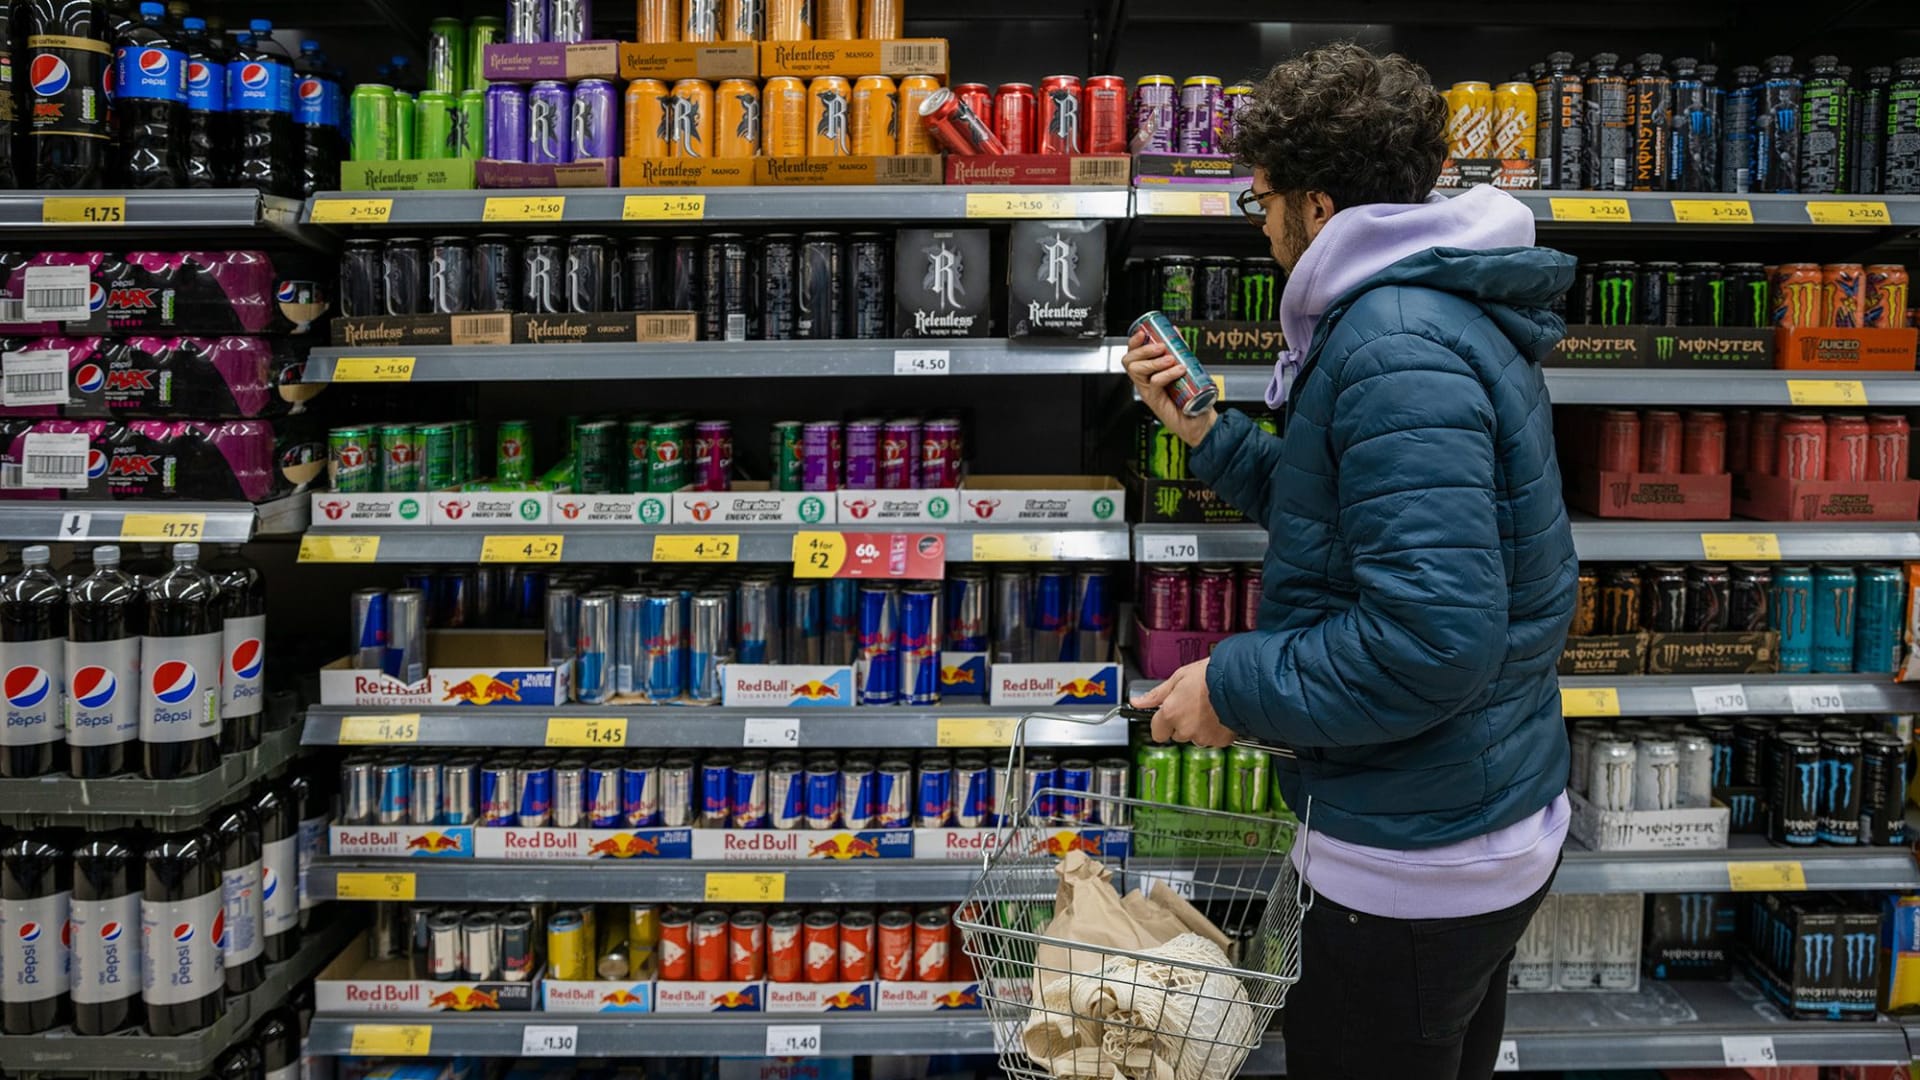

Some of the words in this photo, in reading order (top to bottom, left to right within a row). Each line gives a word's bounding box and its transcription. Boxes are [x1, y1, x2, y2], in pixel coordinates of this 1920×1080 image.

[490, 54, 532, 70] Relentless
[627, 53, 669, 69] Relentless
[775, 46, 836, 70] Relentless
[845, 51, 874, 59] MANGO
[142, 77, 166, 87] pepsi
[243, 90, 266, 98] pepsi
[827, 93, 850, 156] R
[1058, 90, 1081, 155] R
[1636, 91, 1654, 180] MONSTER
[643, 159, 703, 184] Relentless
[767, 158, 831, 182] Relentless
[839, 163, 867, 171] MANGO
[954, 161, 1016, 182] Relentless
[1025, 166, 1057, 175] CHERRY
[365, 168, 419, 190] Relentless
[1433, 176, 1462, 188] ERT
[1491, 176, 1538, 188] ALERT
[351, 207, 357, 215] 2
[524, 205, 530, 213] 2
[664, 203, 670, 211] 2
[1006, 201, 1012, 210] 2
[1712, 208, 1719, 216] 2
[1848, 209, 1855, 217] 2
[84, 206, 121, 222] £1.75
[1046, 231, 1075, 301] R
[111, 278, 135, 288] pepsi
[526, 249, 558, 313] R
[932, 243, 964, 309] R
[107, 287, 160, 309] MAX
[1027, 299, 1089, 327] Relentless
[527, 319, 588, 341] Relentless
[597, 325, 624, 333] ORIGIN
[914, 310, 975, 335] Relentless
[345, 322, 404, 344] Relentless
[412, 326, 441, 335] ORIGIN
[1205, 328, 1285, 350] MONST
[1554, 337, 1637, 352] MONSTER
[1679, 337, 1765, 353] MONSTER
[1817, 339, 1860, 350] JUICED
[1225, 351, 1273, 360] ENER
[110, 360, 132, 370] pepsi
[374, 366, 380, 374] 2
[386, 364, 410, 374] £1.50
[912, 358, 946, 371] £4.50
[103, 369, 155, 391] MAX
[112, 444, 137, 454] pepsi
[107, 453, 160, 475] MAX
[1829, 494, 1869, 503] PUNCH
[642, 504, 661, 516] 63
[803, 503, 821, 515] 63
[931, 502, 945, 512] 63
[1096, 502, 1111, 512] 63
[1821, 505, 1874, 515] MONSTER
[162, 522, 199, 538] £1.75
[523, 543, 532, 556] 4
[694, 542, 704, 556] 4
[810, 538, 817, 549] 4
[819, 541, 833, 549] for
[855, 543, 880, 558] 60p
[1164, 543, 1195, 558] £1.70
[810, 551, 829, 568] £2
[1563, 648, 1631, 660] MONSTER
[1681, 643, 1754, 656] MONSTER
[737, 679, 760, 692] Red
[764, 679, 788, 692] Bull
[1002, 679, 1025, 691] Red
[1030, 678, 1054, 691] Bull
[233, 685, 261, 700] pepsi
[356, 697, 397, 705] ENERGY
[7, 712, 46, 729] pepsi
[76, 712, 113, 728] pepsi
[153, 709, 192, 726] pepsi
[378, 725, 414, 739] £1.45
[586, 727, 622, 742] £1.45
[784, 728, 797, 741] £2
[1637, 823, 1715, 835] MONSTER
[340, 832, 368, 846] Red
[370, 831, 398, 845] Bull
[505, 832, 539, 849] Red
[543, 831, 577, 848] Bull
[724, 833, 759, 850] Red
[763, 833, 797, 850] Bull
[946, 832, 983, 848] Red
[25, 944, 39, 984] pepsi
[106, 944, 121, 983] pepsi
[178, 944, 192, 985] pepsi
[346, 985, 381, 1001] Red
[385, 985, 420, 1000] Bull
[550, 989, 570, 1000] Red
[573, 989, 595, 1000] Bull
[660, 990, 680, 1001] Red
[683, 990, 705, 1001] Bull
[771, 991, 791, 1002] Red
[794, 991, 817, 1002] Bull
[882, 990, 902, 1001] Red
[905, 990, 928, 1001] Bull
[543, 1036, 572, 1050] £1.30
[785, 1036, 817, 1050] £1.40
